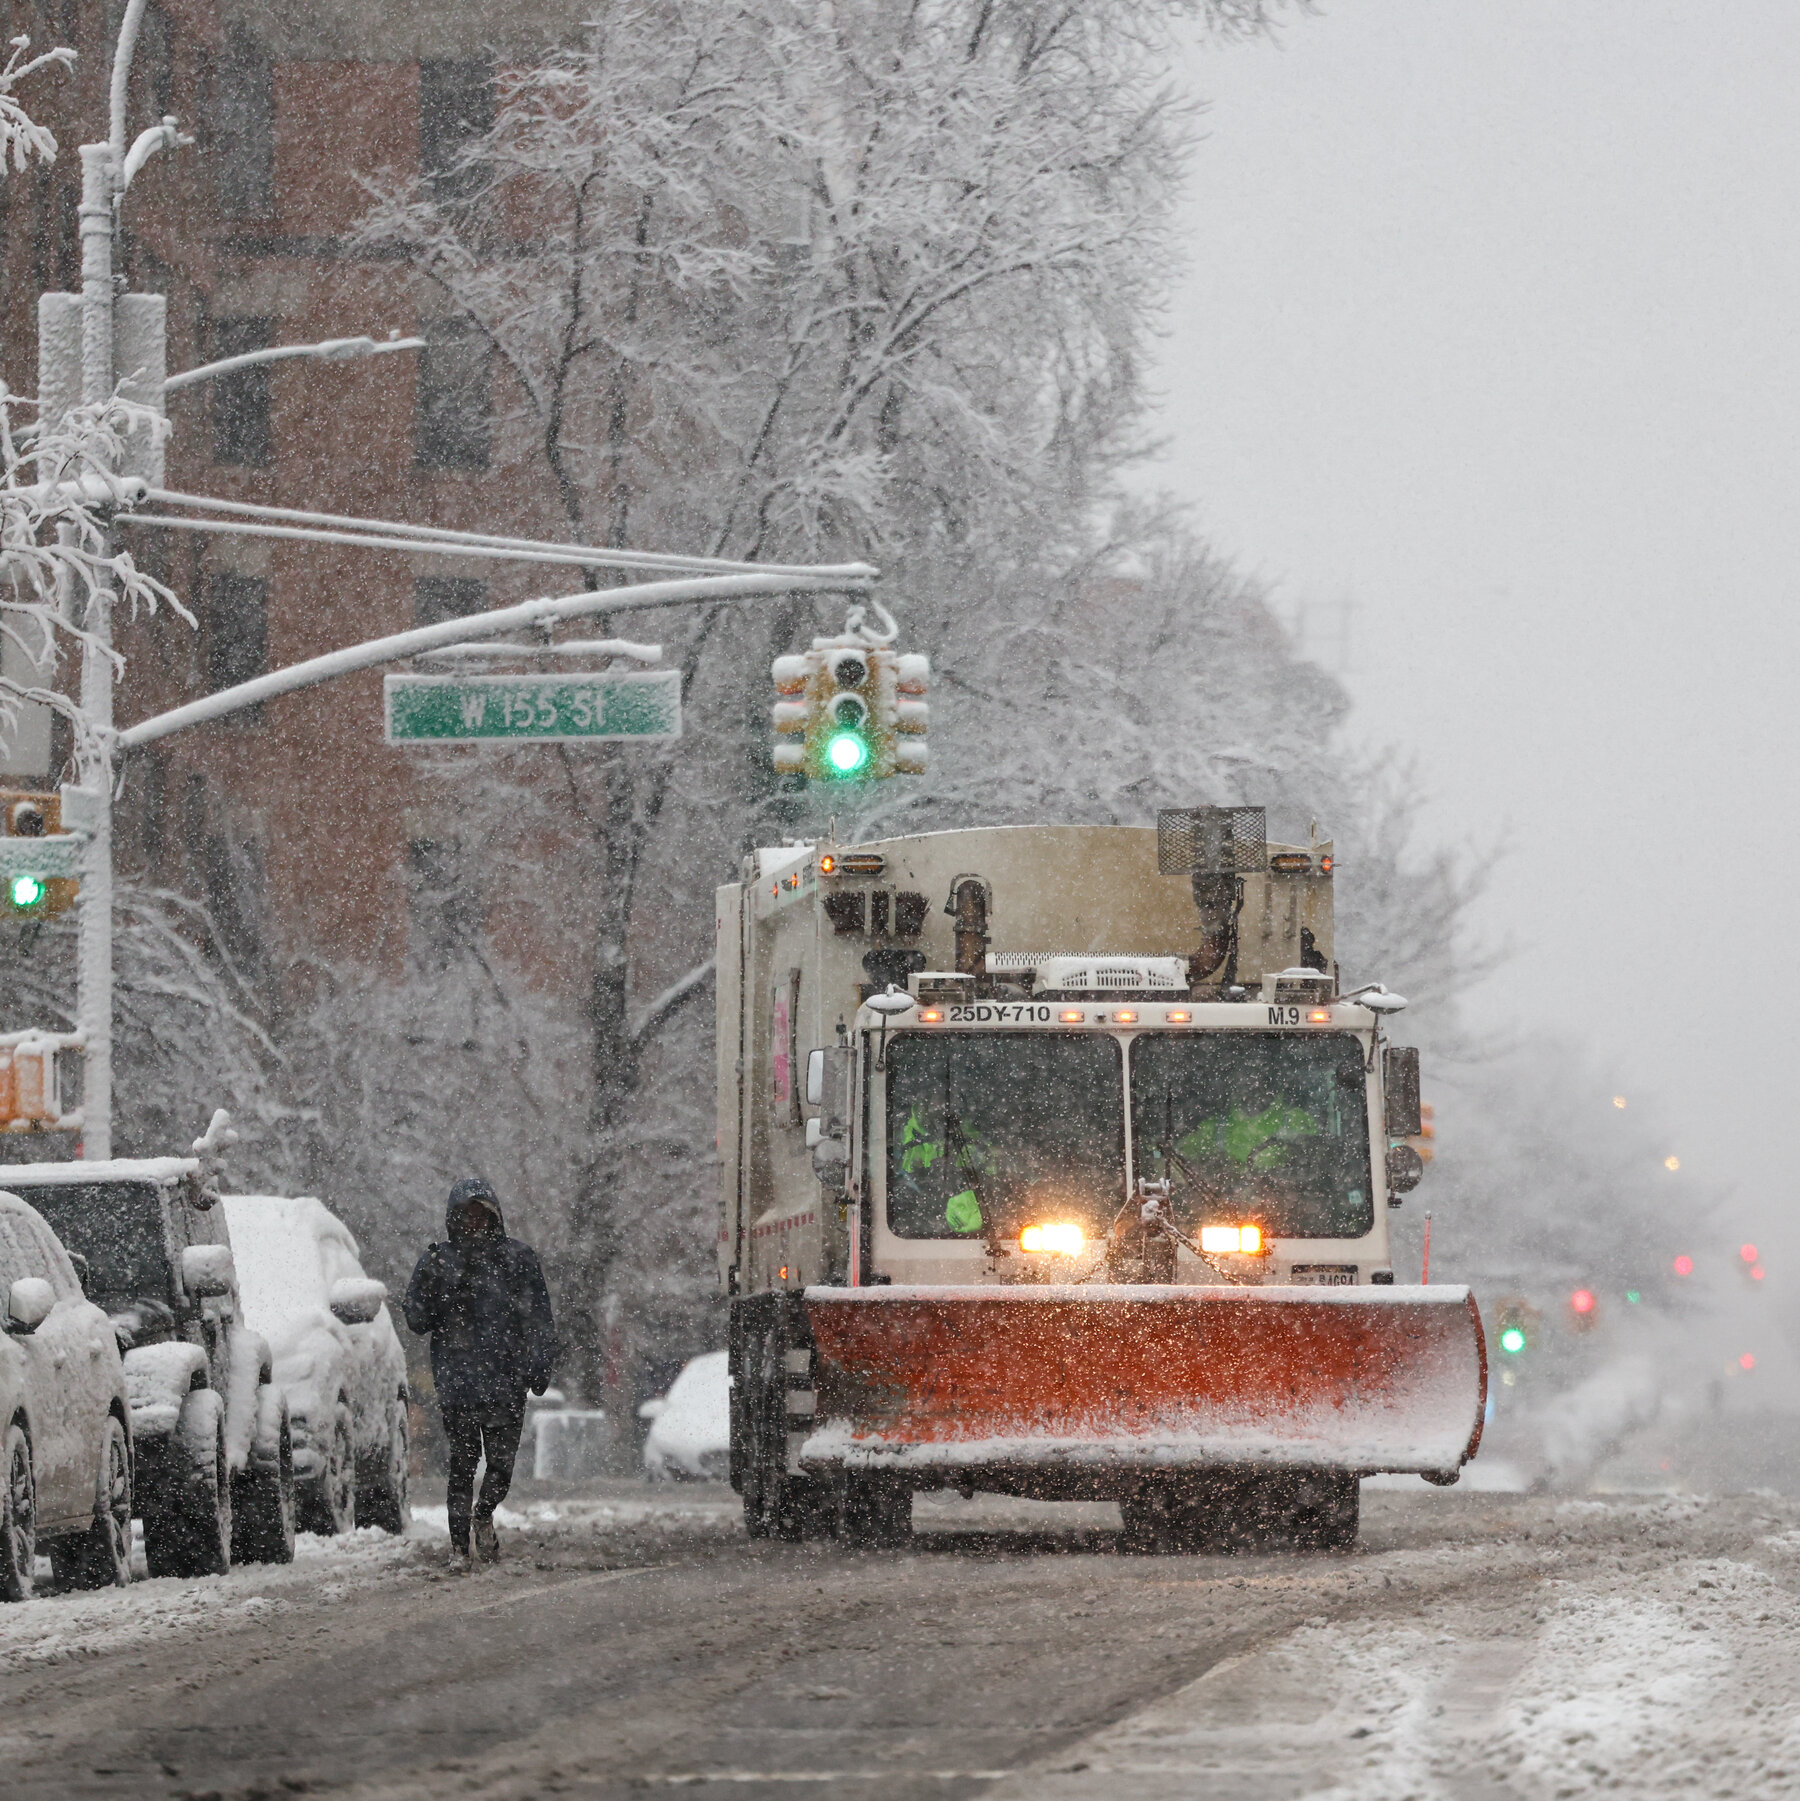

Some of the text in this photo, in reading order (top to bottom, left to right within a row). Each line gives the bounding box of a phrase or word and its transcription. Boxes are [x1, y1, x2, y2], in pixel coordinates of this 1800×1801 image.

[460, 692, 487, 728] W
[503, 689, 558, 728] 155
[949, 1005, 1051, 1022] 25DY-710
[1268, 1006, 1300, 1026] M.9
